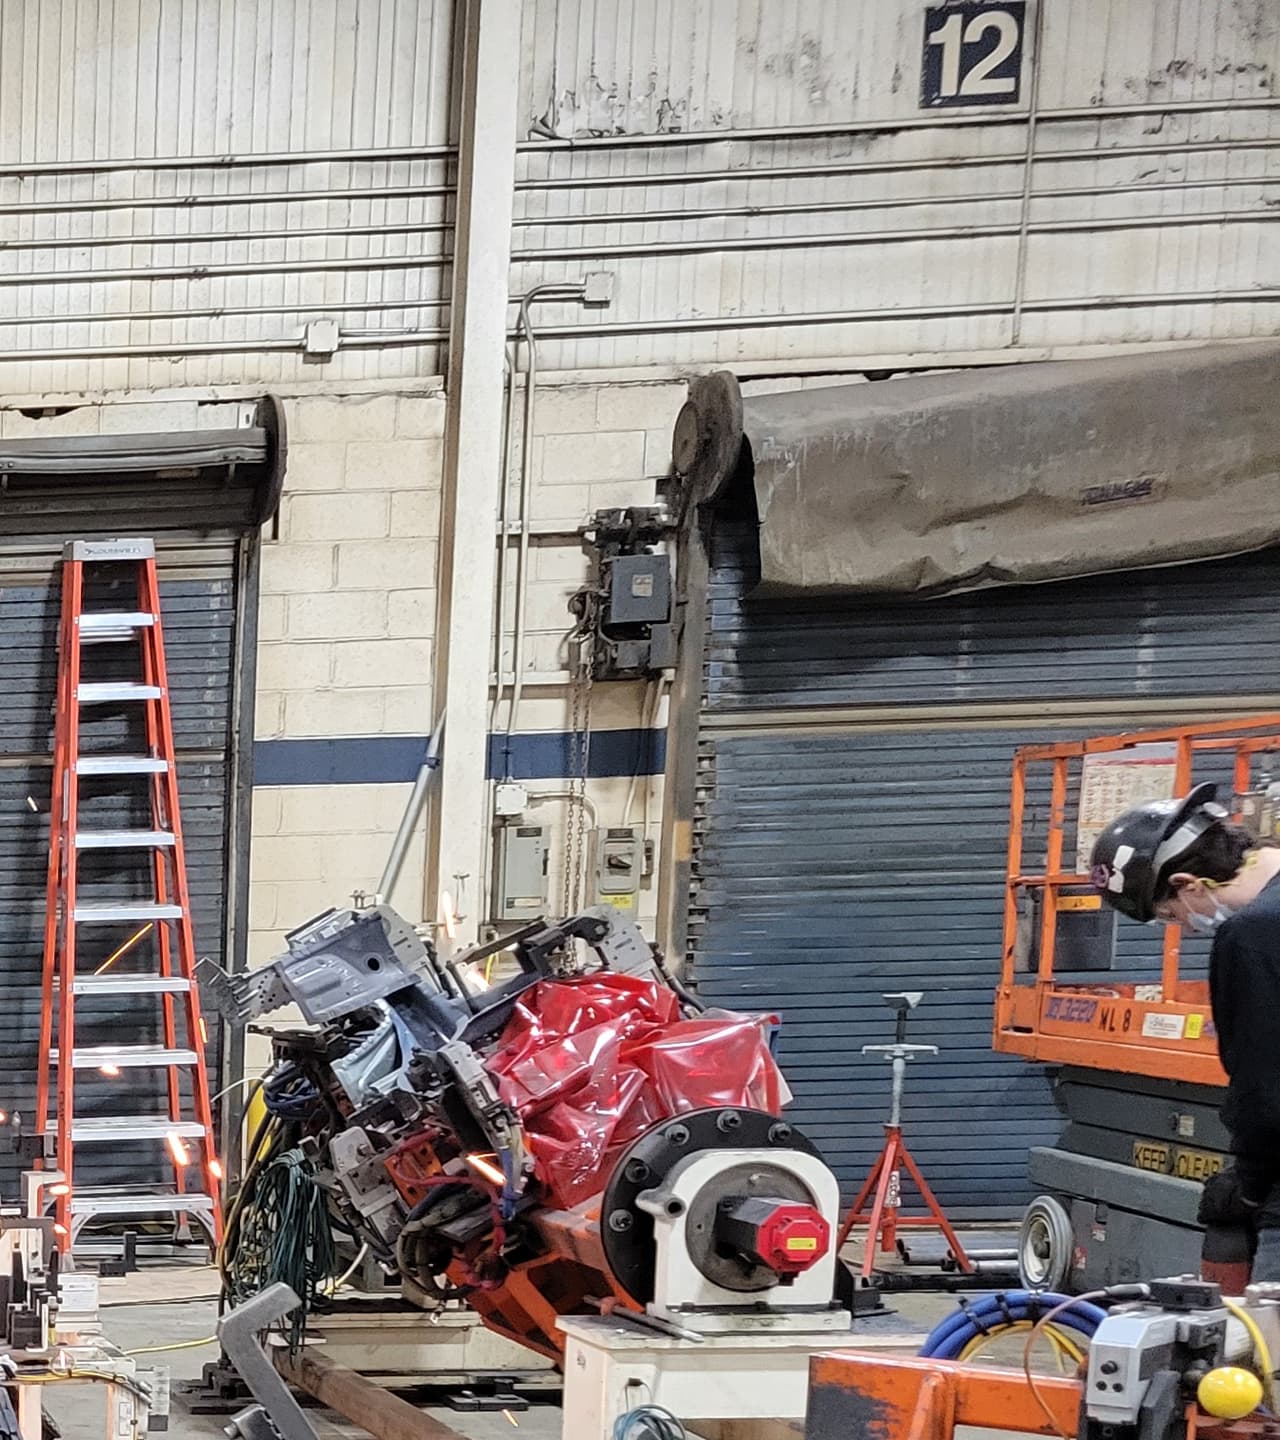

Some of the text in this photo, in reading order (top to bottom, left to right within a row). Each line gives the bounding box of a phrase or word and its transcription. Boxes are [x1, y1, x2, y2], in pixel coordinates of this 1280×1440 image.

[929, 10, 1018, 96] 12
[1122, 1007, 1132, 1033] 8
[1135, 1146, 1166, 1173] KEEP
